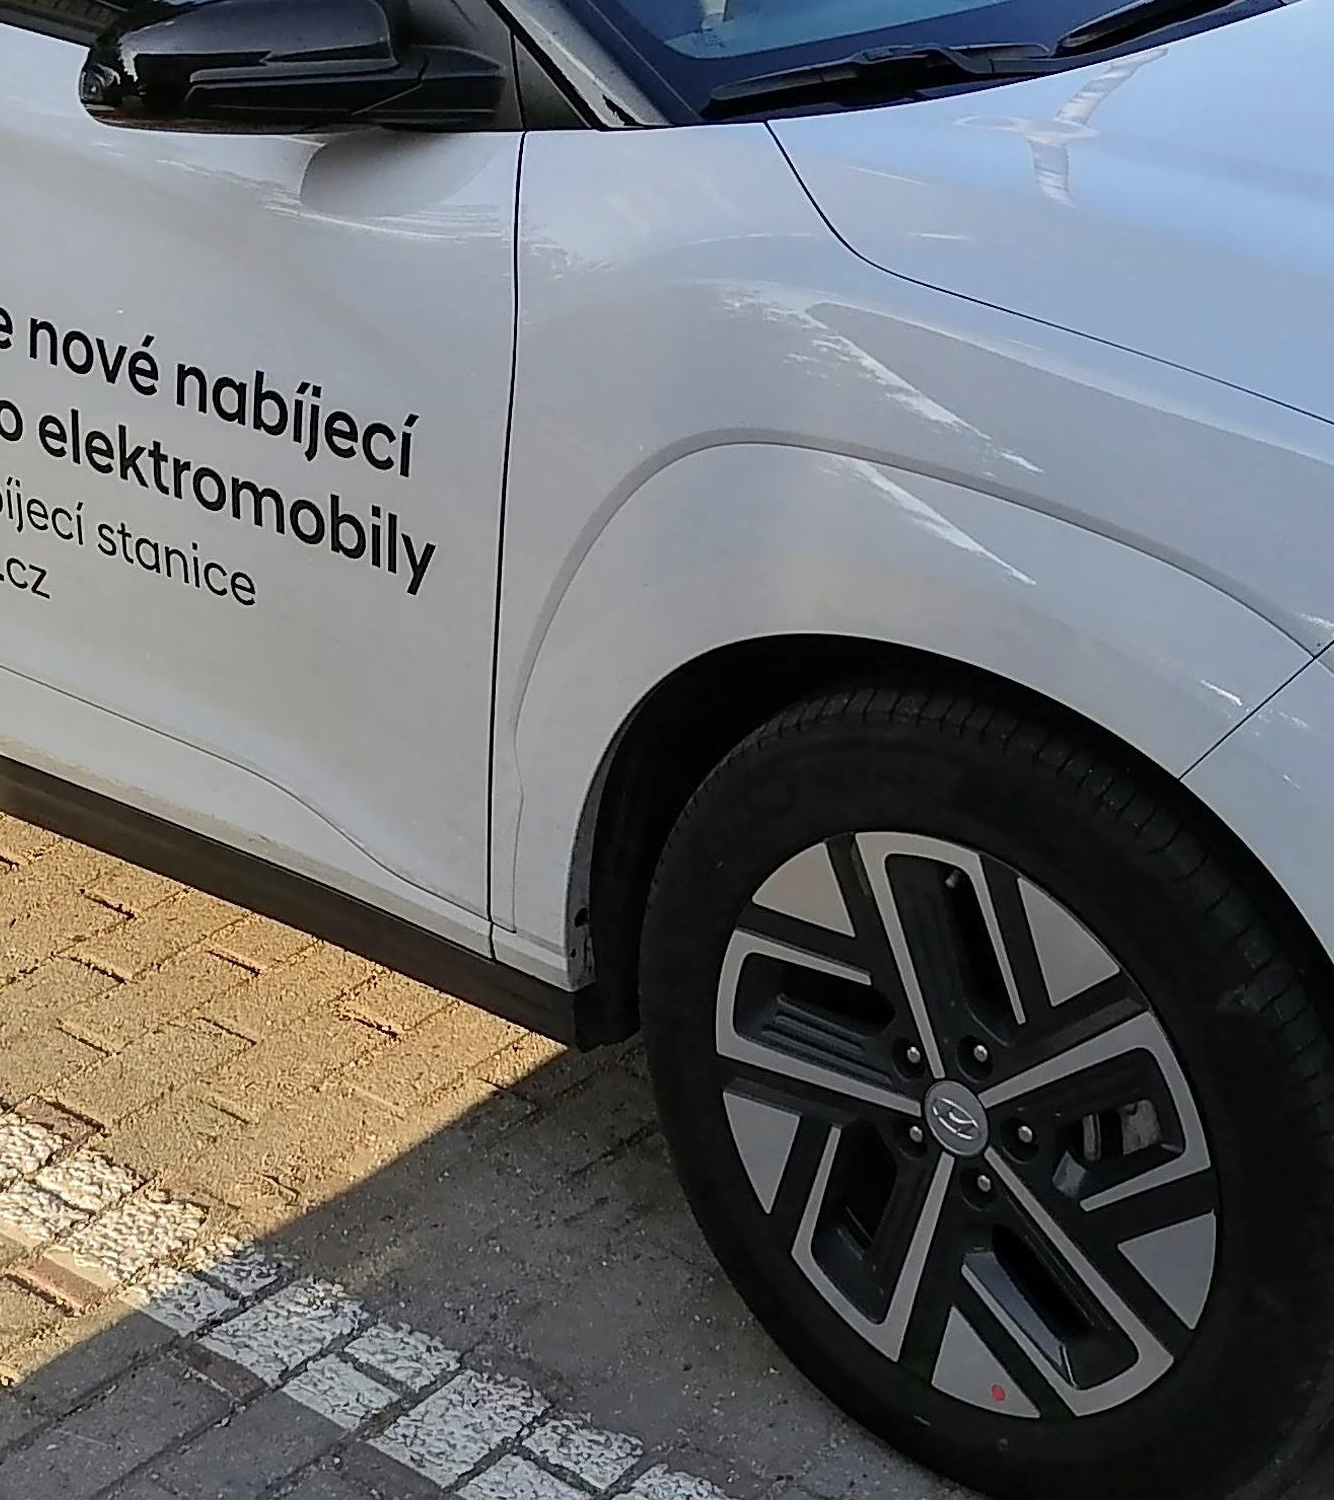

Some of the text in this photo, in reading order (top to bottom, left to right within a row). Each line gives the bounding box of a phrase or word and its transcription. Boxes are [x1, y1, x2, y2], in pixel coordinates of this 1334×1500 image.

[29, 317, 159, 396] nové
[176, 363, 419, 478] nabíjecí
[38, 408, 436, 596] elektromobily
[97, 522, 257, 607] stanice
